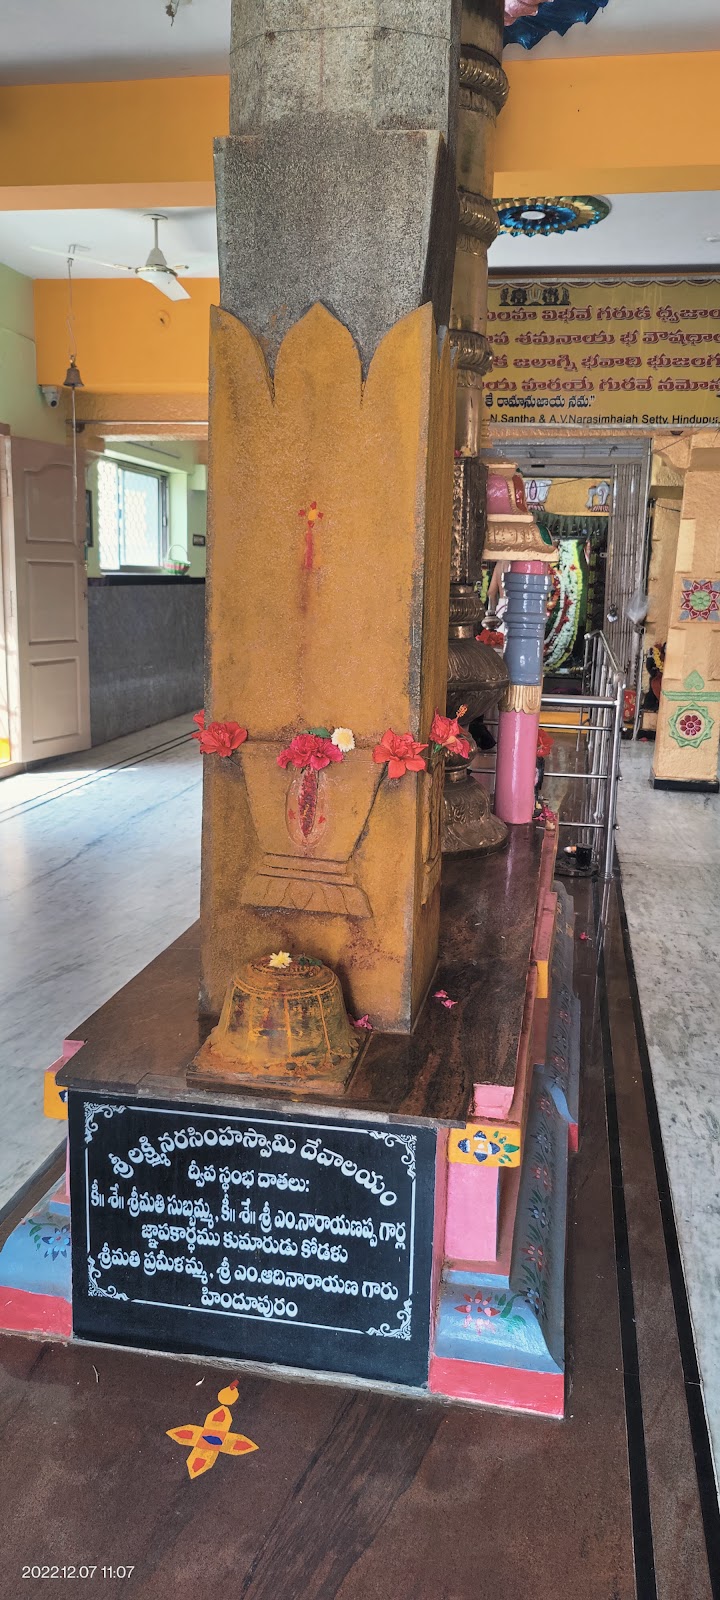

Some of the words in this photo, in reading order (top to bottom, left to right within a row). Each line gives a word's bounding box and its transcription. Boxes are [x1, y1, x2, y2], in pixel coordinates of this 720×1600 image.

[596, 305, 651, 320] గరుడ
[515, 330, 616, 345] శమనాయ
[599, 375, 653, 391] గురవే
[497, 394, 565, 409] రామానుజాయ
[539, 414, 546, 423] &
[108, 1153, 134, 1179] శ్రీ
[300, 1138, 397, 1206] దేవాలయం
[127, 1186, 166, 1217] శ్రీమతి
[258, 1201, 273, 1233] శ్రీ
[274, 1210, 378, 1247] ఎం.నారాయణప్ప
[223, 1231, 298, 1256] కుమారుడు
[97, 1242, 141, 1269] శ్రీమతి
[216, 1256, 232, 1284] శ్రీ
[234, 1263, 359, 1296] ఎం.ఆదినారాయణ
[361, 1281, 399, 1300] గారు
[201, 1286, 298, 1317] హిందూపురం
